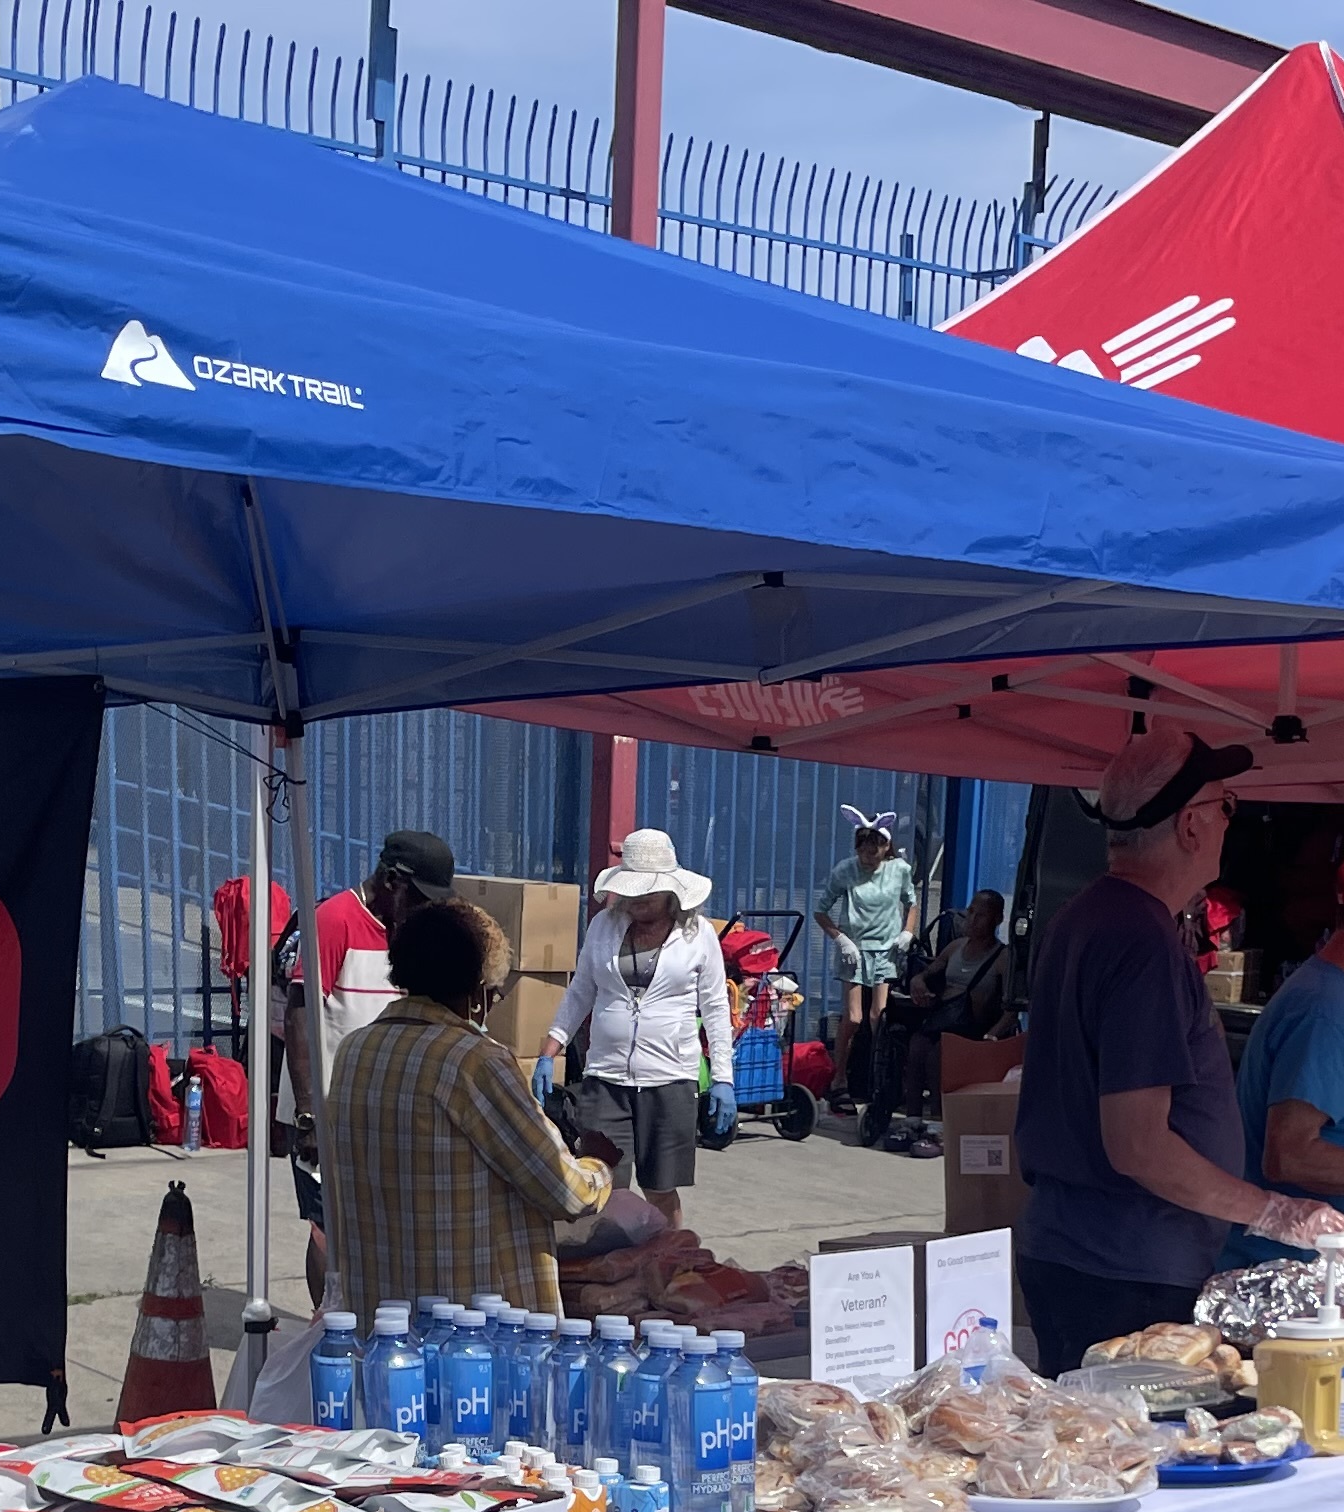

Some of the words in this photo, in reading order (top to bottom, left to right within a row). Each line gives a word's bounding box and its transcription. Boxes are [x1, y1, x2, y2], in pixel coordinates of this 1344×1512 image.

[193, 355, 287, 395] OZARK
[288, 373, 364, 410] TRAIL
[860, 1271, 873, 1280] You
[874, 1270, 880, 1279] A
[841, 1294, 888, 1313] Veteran?
[317, 1391, 348, 1424] pH
[396, 1394, 425, 1433] pH
[457, 1387, 489, 1423] pH
[632, 1402, 659, 1430] pH
[701, 1418, 730, 1458] pH
